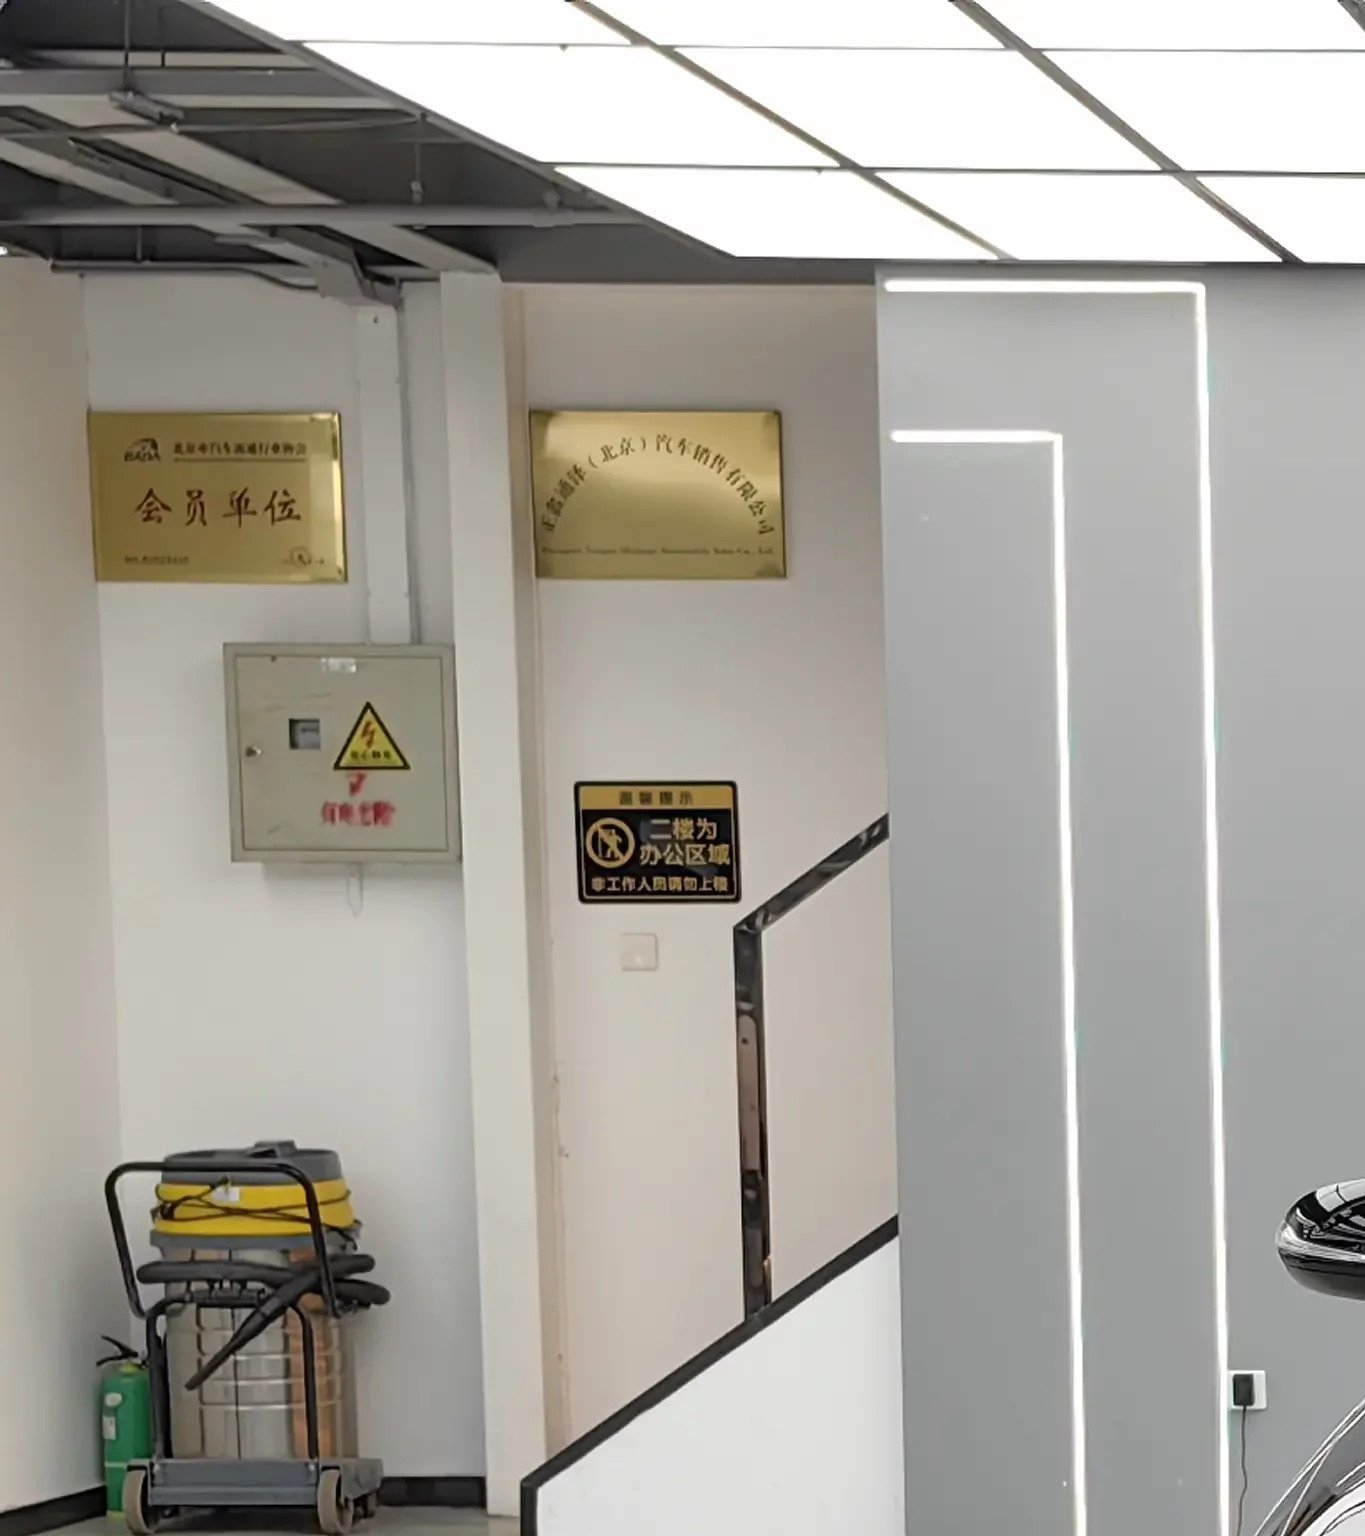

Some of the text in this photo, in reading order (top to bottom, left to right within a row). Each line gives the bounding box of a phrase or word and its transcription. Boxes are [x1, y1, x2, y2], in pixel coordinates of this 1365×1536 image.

[135, 488, 302, 527] 会员单位
[650, 817, 718, 841] 二楼为
[639, 844, 731, 866] 办公区域
